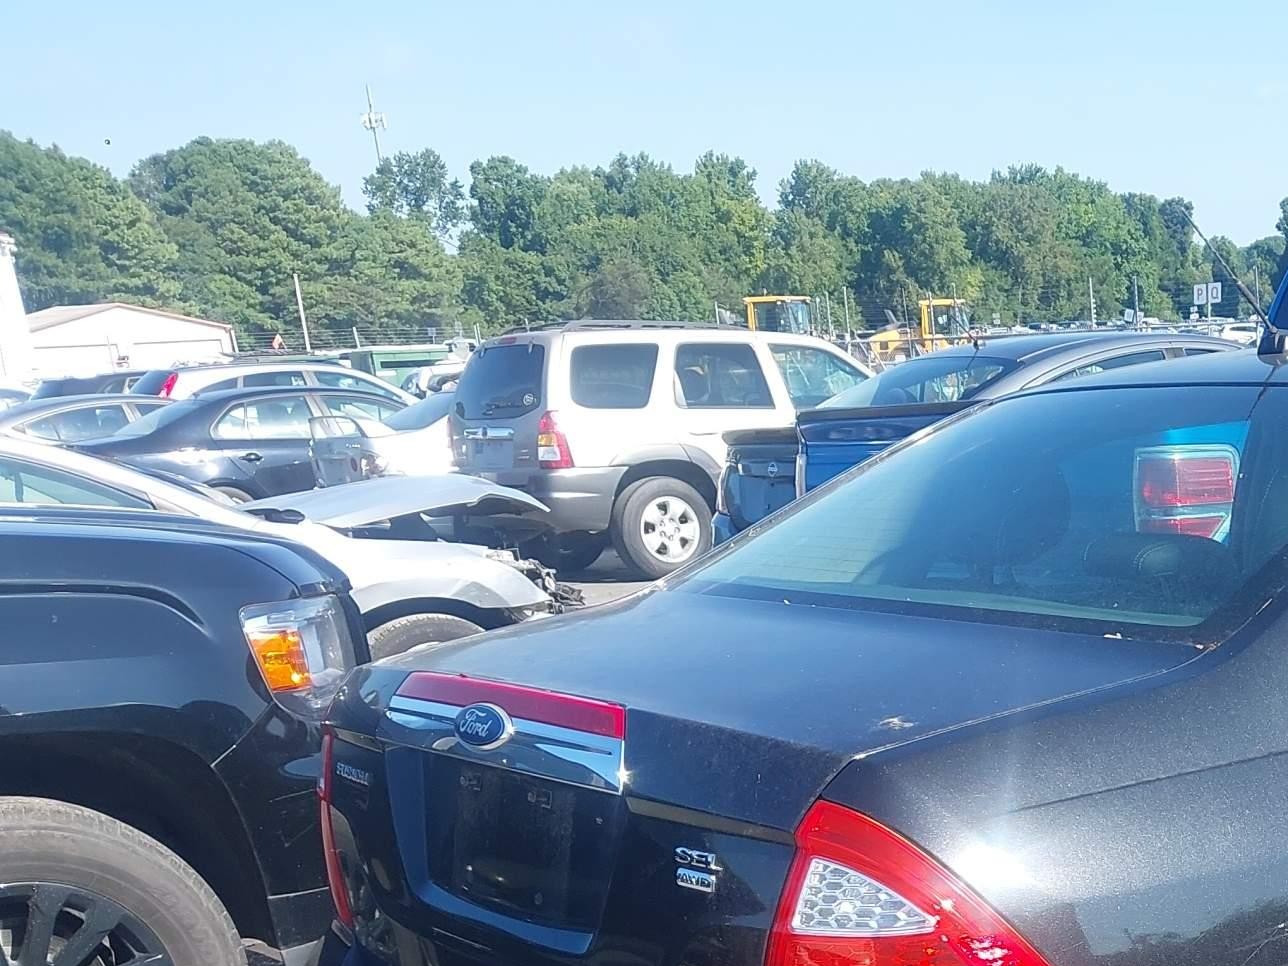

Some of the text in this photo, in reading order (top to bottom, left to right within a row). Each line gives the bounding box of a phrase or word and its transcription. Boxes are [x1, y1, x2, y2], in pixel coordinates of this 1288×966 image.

[1197, 287, 1204, 301] P
[1211, 286, 1219, 299] Q
[459, 708, 493, 738] Ford
[674, 846, 723, 871] SEL
[676, 871, 712, 889] AWD
